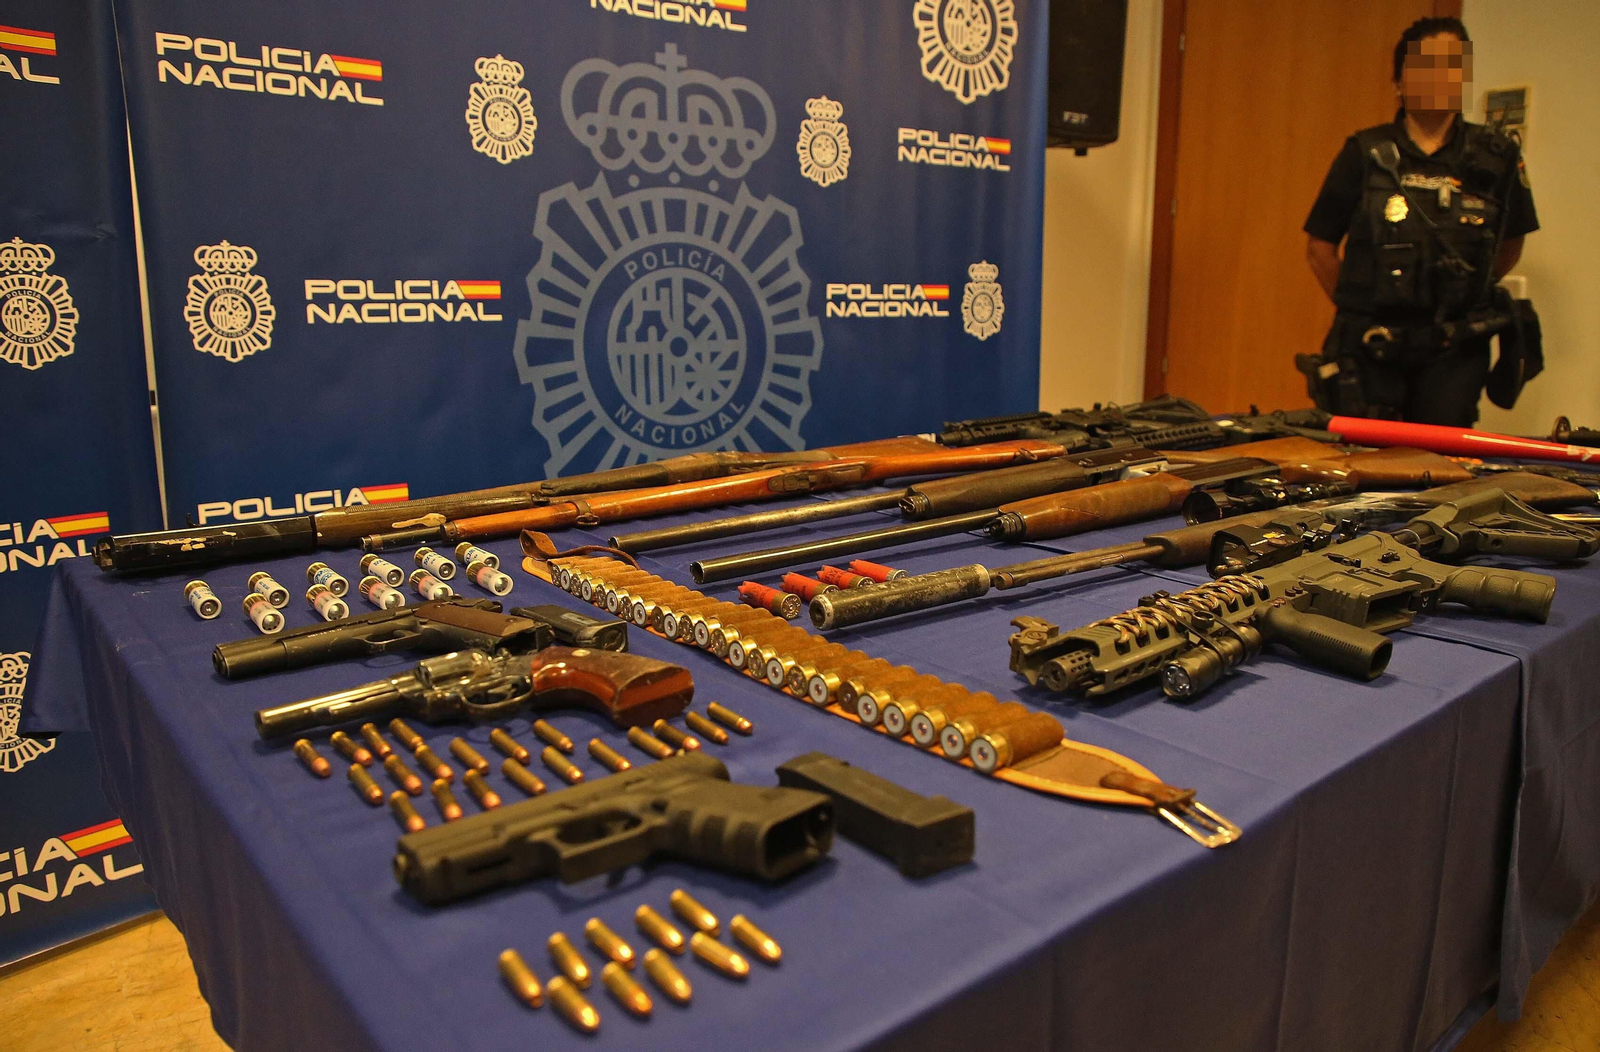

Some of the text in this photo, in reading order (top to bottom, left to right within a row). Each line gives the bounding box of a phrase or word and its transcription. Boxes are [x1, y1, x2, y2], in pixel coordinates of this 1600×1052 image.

[158, 59, 385, 106] NACIONAL
[898, 145, 1011, 172] NACIONAL
[306, 302, 503, 324] NACIONAL
[826, 301, 950, 318] NACIONAL
[5, 330, 51, 343] NACIONAL
[614, 401, 746, 445] NACIONAL
